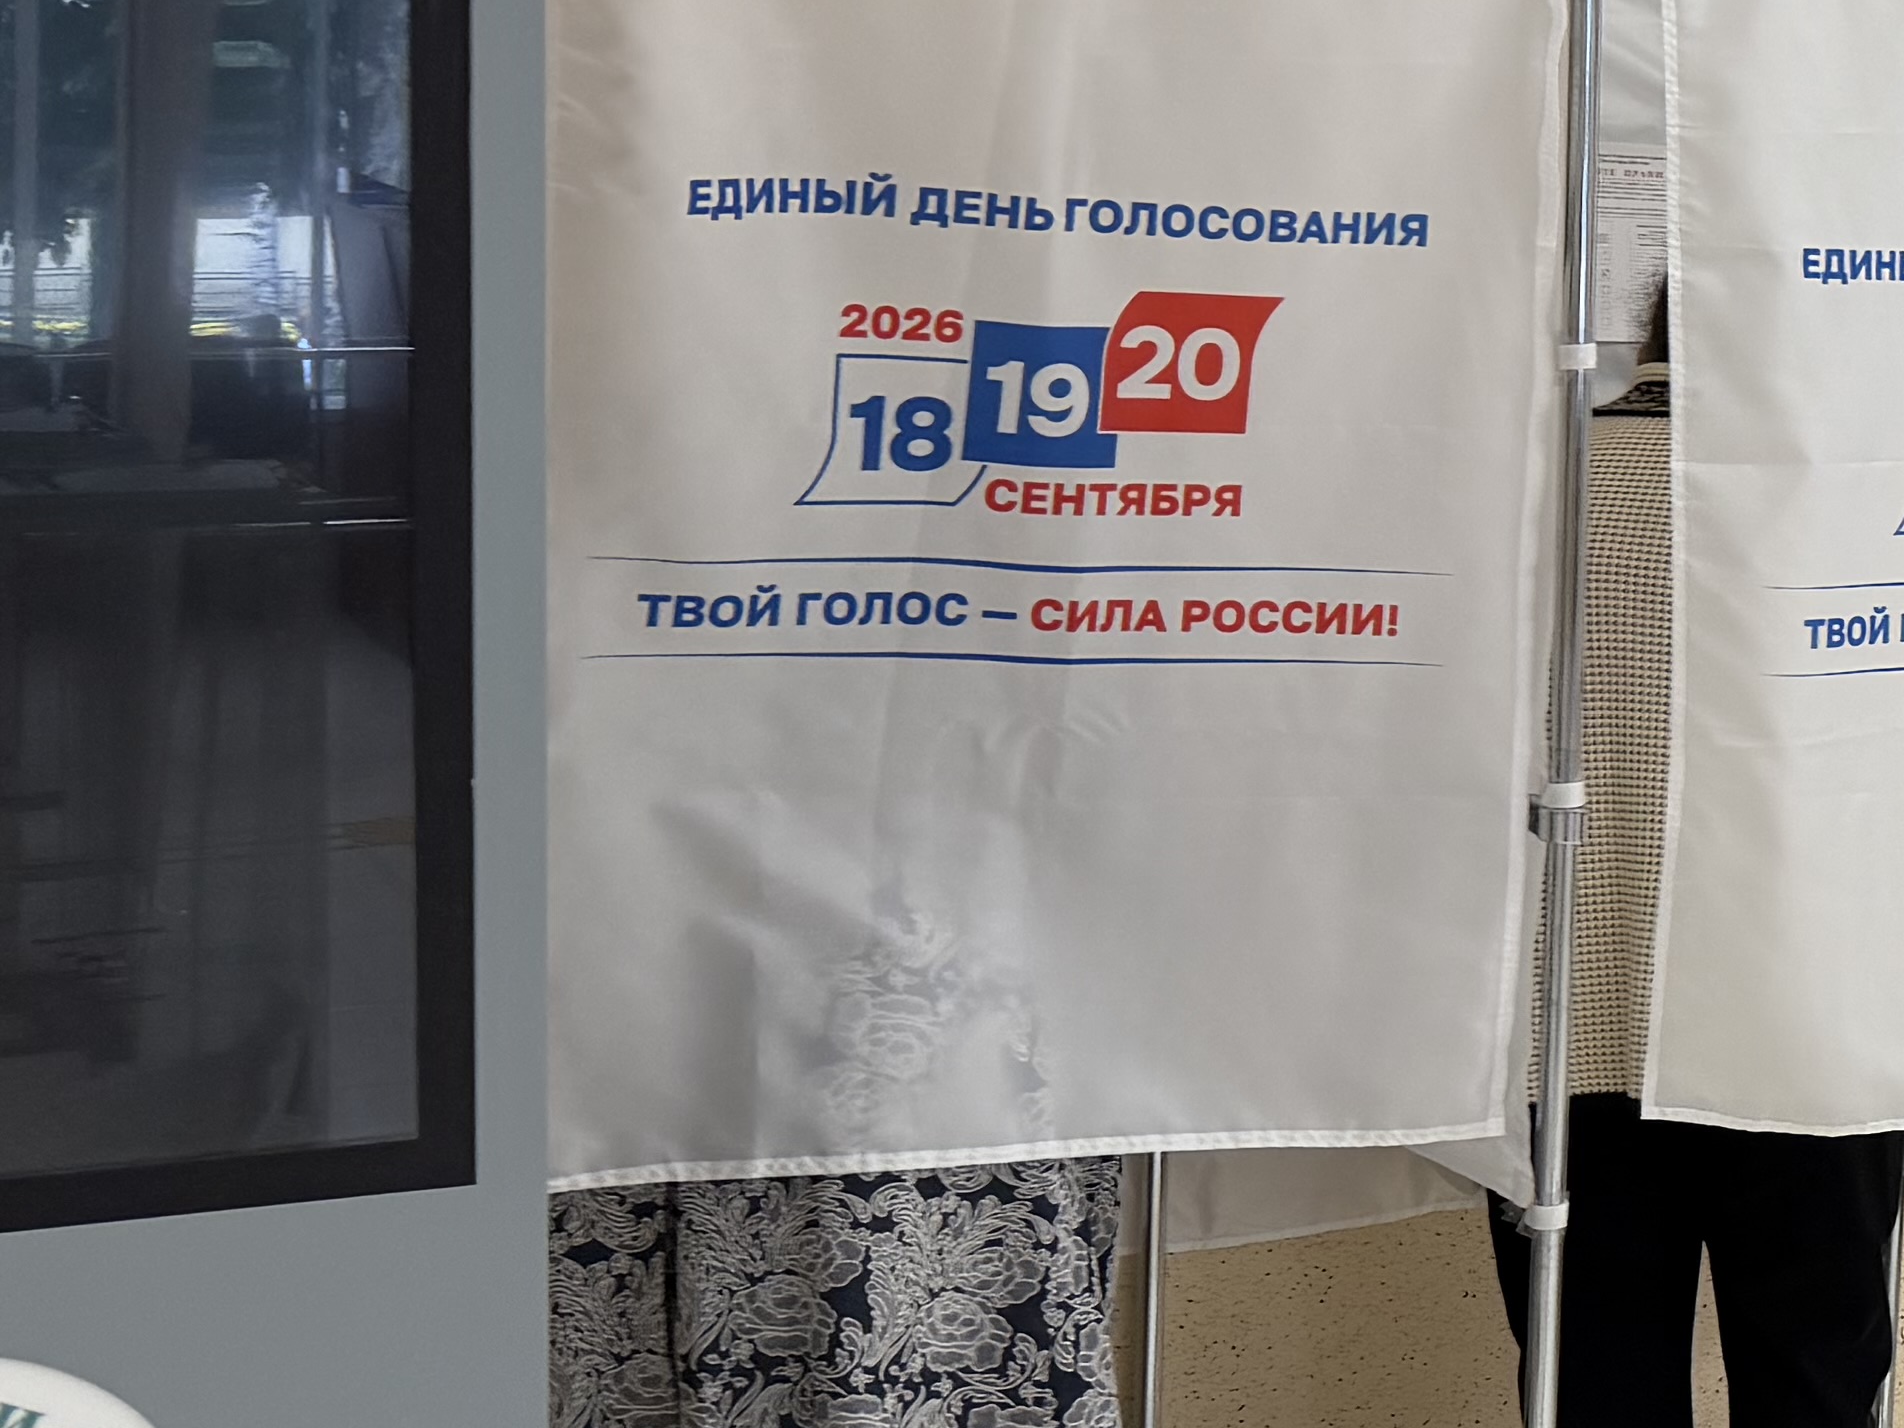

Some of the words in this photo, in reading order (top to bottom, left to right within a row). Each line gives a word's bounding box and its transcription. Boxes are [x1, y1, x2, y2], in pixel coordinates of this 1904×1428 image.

[688, 173, 898, 221] ЕДИНЫЙ
[910, 187, 1056, 232] ДЕНЬ
[1065, 198, 1430, 248] ГОЛОСОВАНИЯ
[838, 302, 965, 345] 2026
[849, 395, 953, 474] 18
[986, 360, 1091, 438] 19
[1116, 326, 1240, 402] 20
[984, 478, 1244, 519] СЕНТЯБРЯ
[638, 586, 783, 630] ТВОЙ
[797, 591, 970, 628] ГОЛОС
[1030, 598, 1168, 634] СИЛА
[1180, 600, 1400, 638] РОССИИ!
[1803, 606, 1892, 650] ТВОЙ
